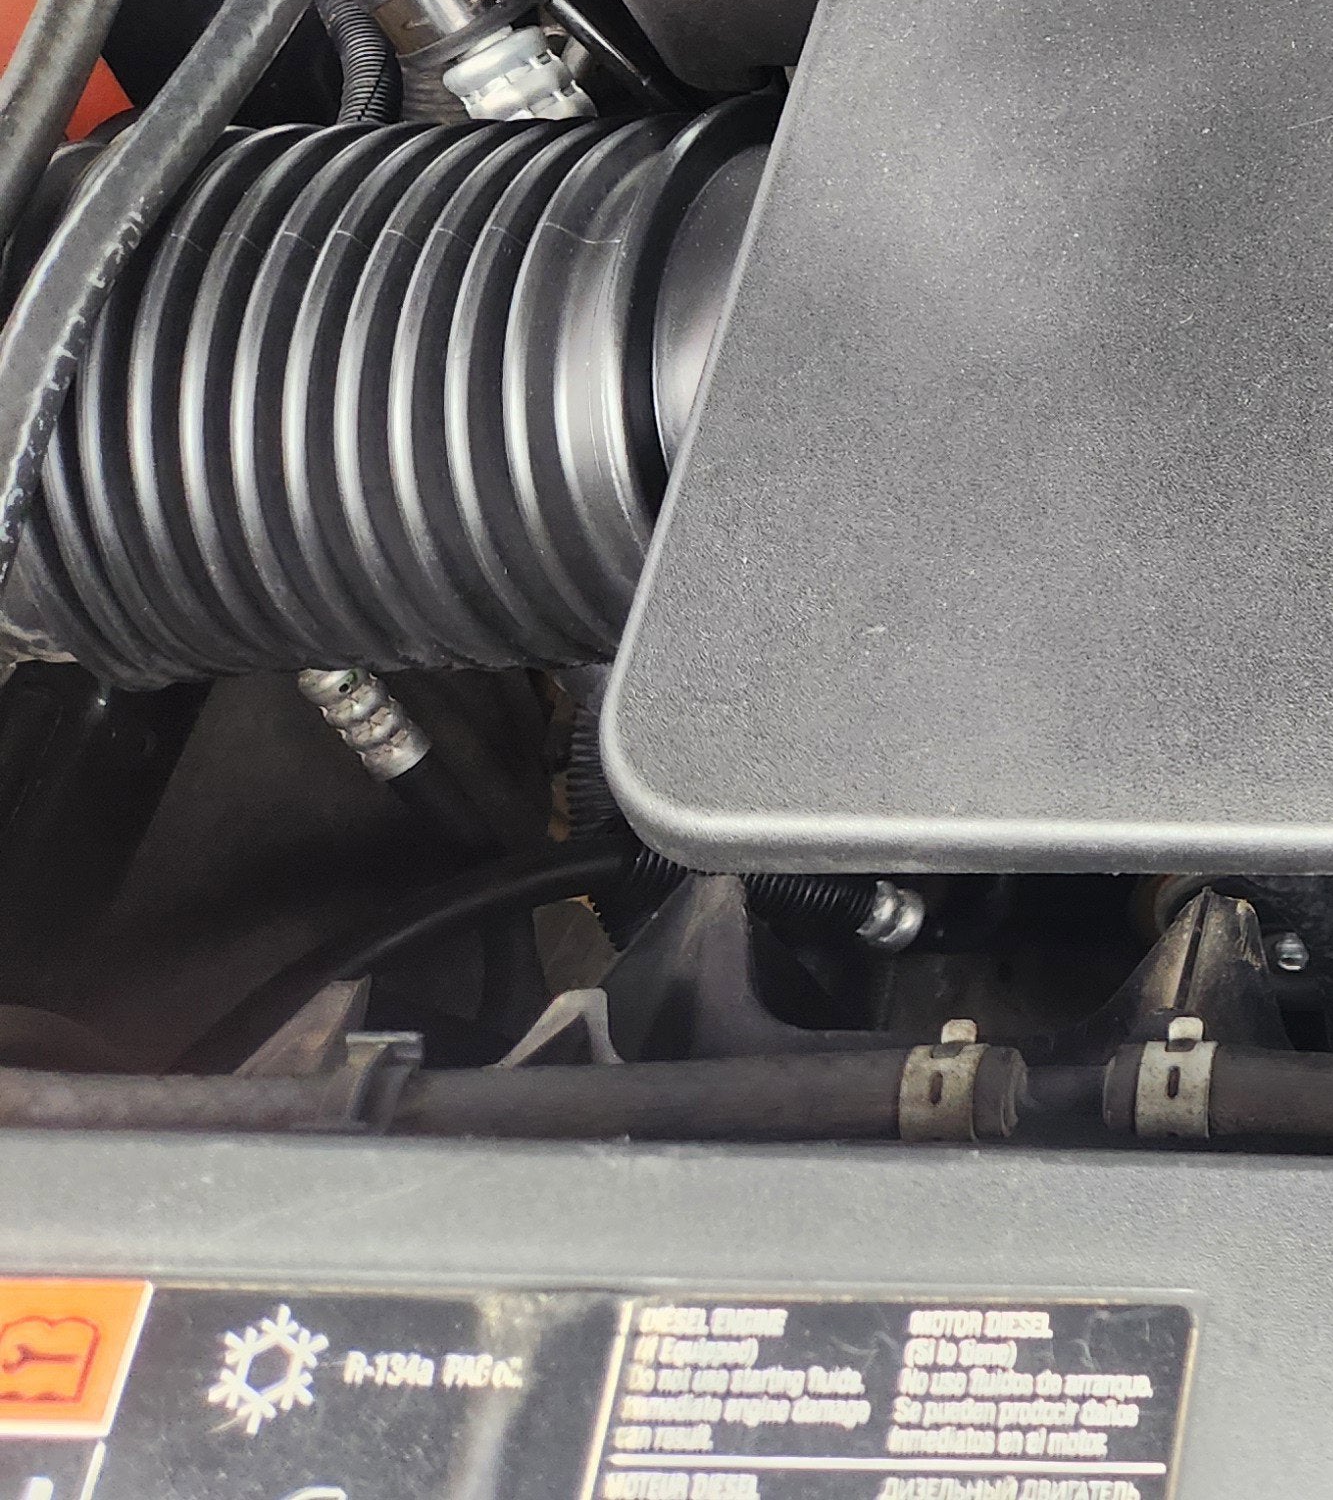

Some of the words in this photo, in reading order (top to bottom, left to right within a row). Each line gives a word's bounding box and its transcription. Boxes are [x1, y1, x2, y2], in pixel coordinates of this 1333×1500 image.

[638, 1307, 709, 1336] DIESEL
[711, 1308, 788, 1337] ENGINE
[909, 1310, 983, 1338] MOTOR
[984, 1311, 1054, 1339] DIESEL
[443, 1354, 494, 1389] PAG
[627, 1364, 656, 1392] Do
[657, 1368, 692, 1393] not
[692, 1370, 729, 1394] use
[729, 1366, 806, 1398] starting
[899, 1368, 928, 1395] No
[929, 1371, 967, 1396] use
[968, 1368, 1034, 1397] fluidos
[1035, 1369, 1062, 1396] de
[620, 1394, 722, 1422] Immediate
[723, 1397, 791, 1427] engine
[791, 1396, 871, 1429] damage
[893, 1396, 922, 1423] Se
[923, 1398, 997, 1428] pueden
[997, 1399, 1080, 1429] producir
[614, 1426, 652, 1450] can
[997, 1431, 1023, 1454] en
[1025, 1428, 1047, 1454] el
[604, 1472, 689, 1500] MOTEUR
[690, 1473, 761, 1500] DIESEL
